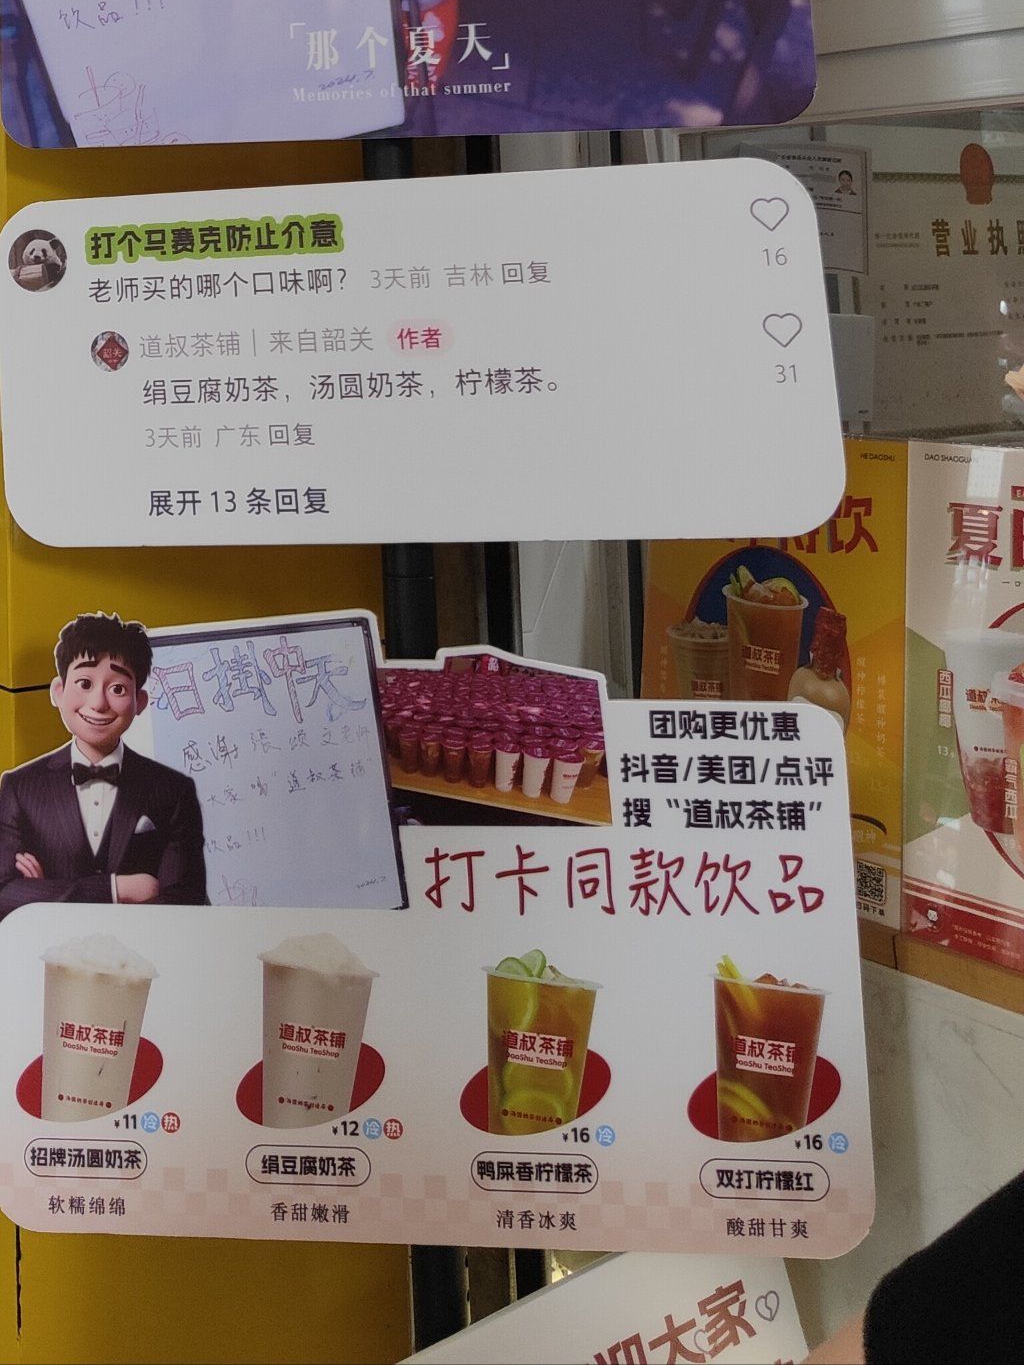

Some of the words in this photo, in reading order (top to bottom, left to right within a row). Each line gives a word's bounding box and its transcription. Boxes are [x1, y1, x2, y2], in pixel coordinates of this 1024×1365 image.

[292, 85, 373, 104] Memories
[380, 85, 398, 99] of
[404, 83, 437, 98] that
[443, 80, 512, 96] summer
[91, 219, 338, 260] 打个马赛克防止介意
[763, 247, 788, 267] 16
[370, 266, 431, 290] 3天前
[444, 263, 494, 289] 吉林
[501, 260, 552, 285] 回复
[397, 326, 443, 351] 作者
[775, 364, 798, 384] 31
[144, 425, 202, 449] 3天前
[215, 423, 260, 448] 广东
[268, 422, 316, 446] 回复
[148, 489, 202, 517] 展开
[210, 489, 238, 514] 13
[245, 486, 330, 516] 条回复
[945, 501, 1024, 570] 夏
[648, 709, 801, 742] 团购更优惠
[620, 752, 835, 788] 抖音/美团/点评
[424, 844, 825, 917] 打卡同款饮品
[59, 1021, 126, 1048] 道叔茶铺
[278, 1022, 347, 1050] 道叔茶铺
[503, 1029, 575, 1059] 道叔茶铺
[535, 1056, 568, 1069] TeaShop
[142, 1114, 159, 1132] 冷
[162, 1114, 180, 1132] 热
[364, 1121, 381, 1138] 冷
[385, 1120, 403, 1138] 热
[596, 1127, 614, 1145] 冷
[829, 1134, 847, 1153] 冷
[30, 1146, 142, 1171] 招牌汤圆奶茶
[261, 1153, 356, 1178] 绢豆腐奶茶
[476, 1160, 593, 1185] 鸭屎香柠檬茶
[716, 1167, 814, 1192] 双打柠檬红
[48, 1194, 127, 1216] 软糯绵绵
[270, 1202, 350, 1224] 香甜嫩滑
[496, 1209, 577, 1231] 清香冰爽
[726, 1217, 809, 1239] 酸甜甘爽
